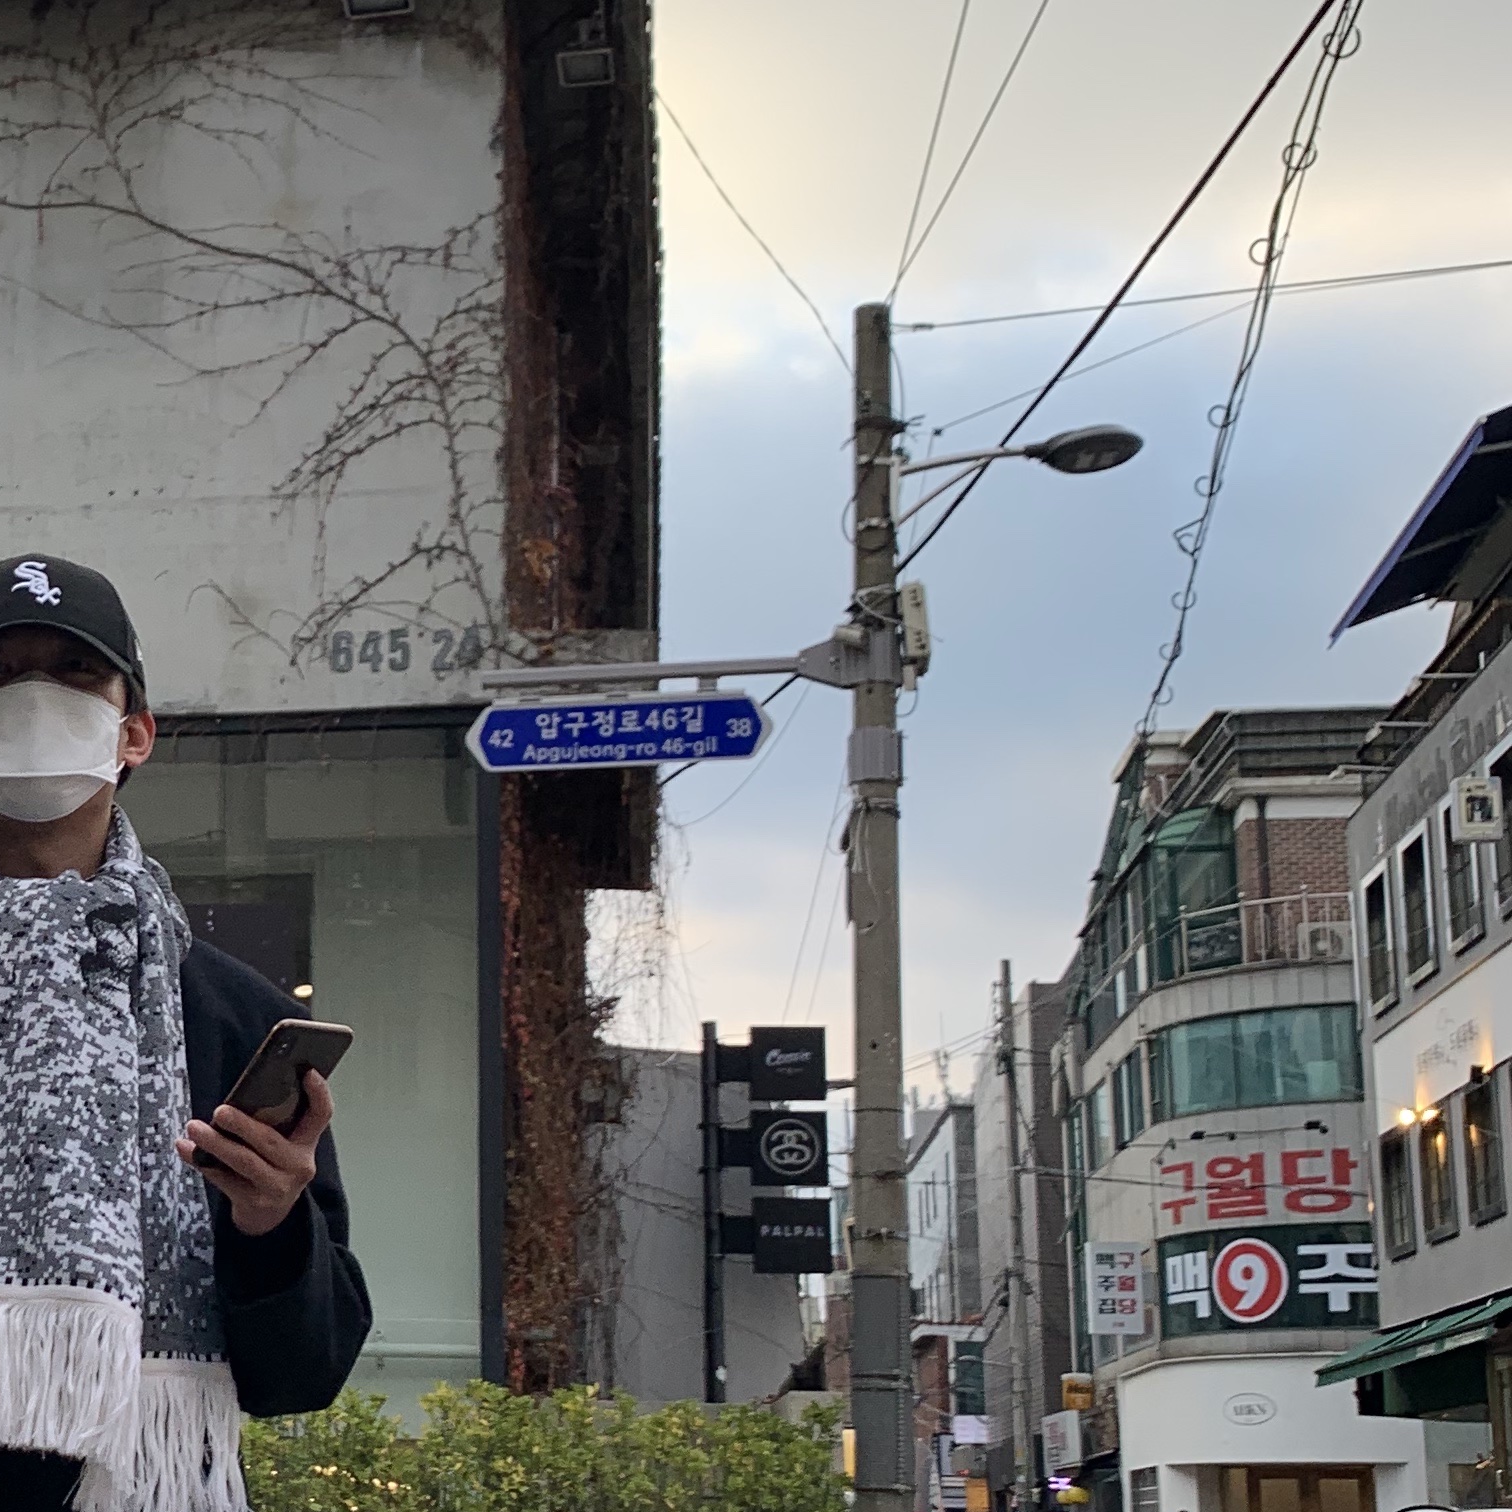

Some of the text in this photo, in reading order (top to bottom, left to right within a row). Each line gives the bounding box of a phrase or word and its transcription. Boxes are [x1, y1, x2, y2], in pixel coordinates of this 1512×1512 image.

[329, 628, 411, 673] 645
[535, 705, 704, 740] 압구정로46길
[726, 717, 752, 738] 38
[488, 728, 514, 749] 42
[522, 736, 718, 764] Apgujeong-ro 46-gil
[1160, 1148, 1358, 1225] 구월당
[760, 1225, 825, 1237] PALPAL
